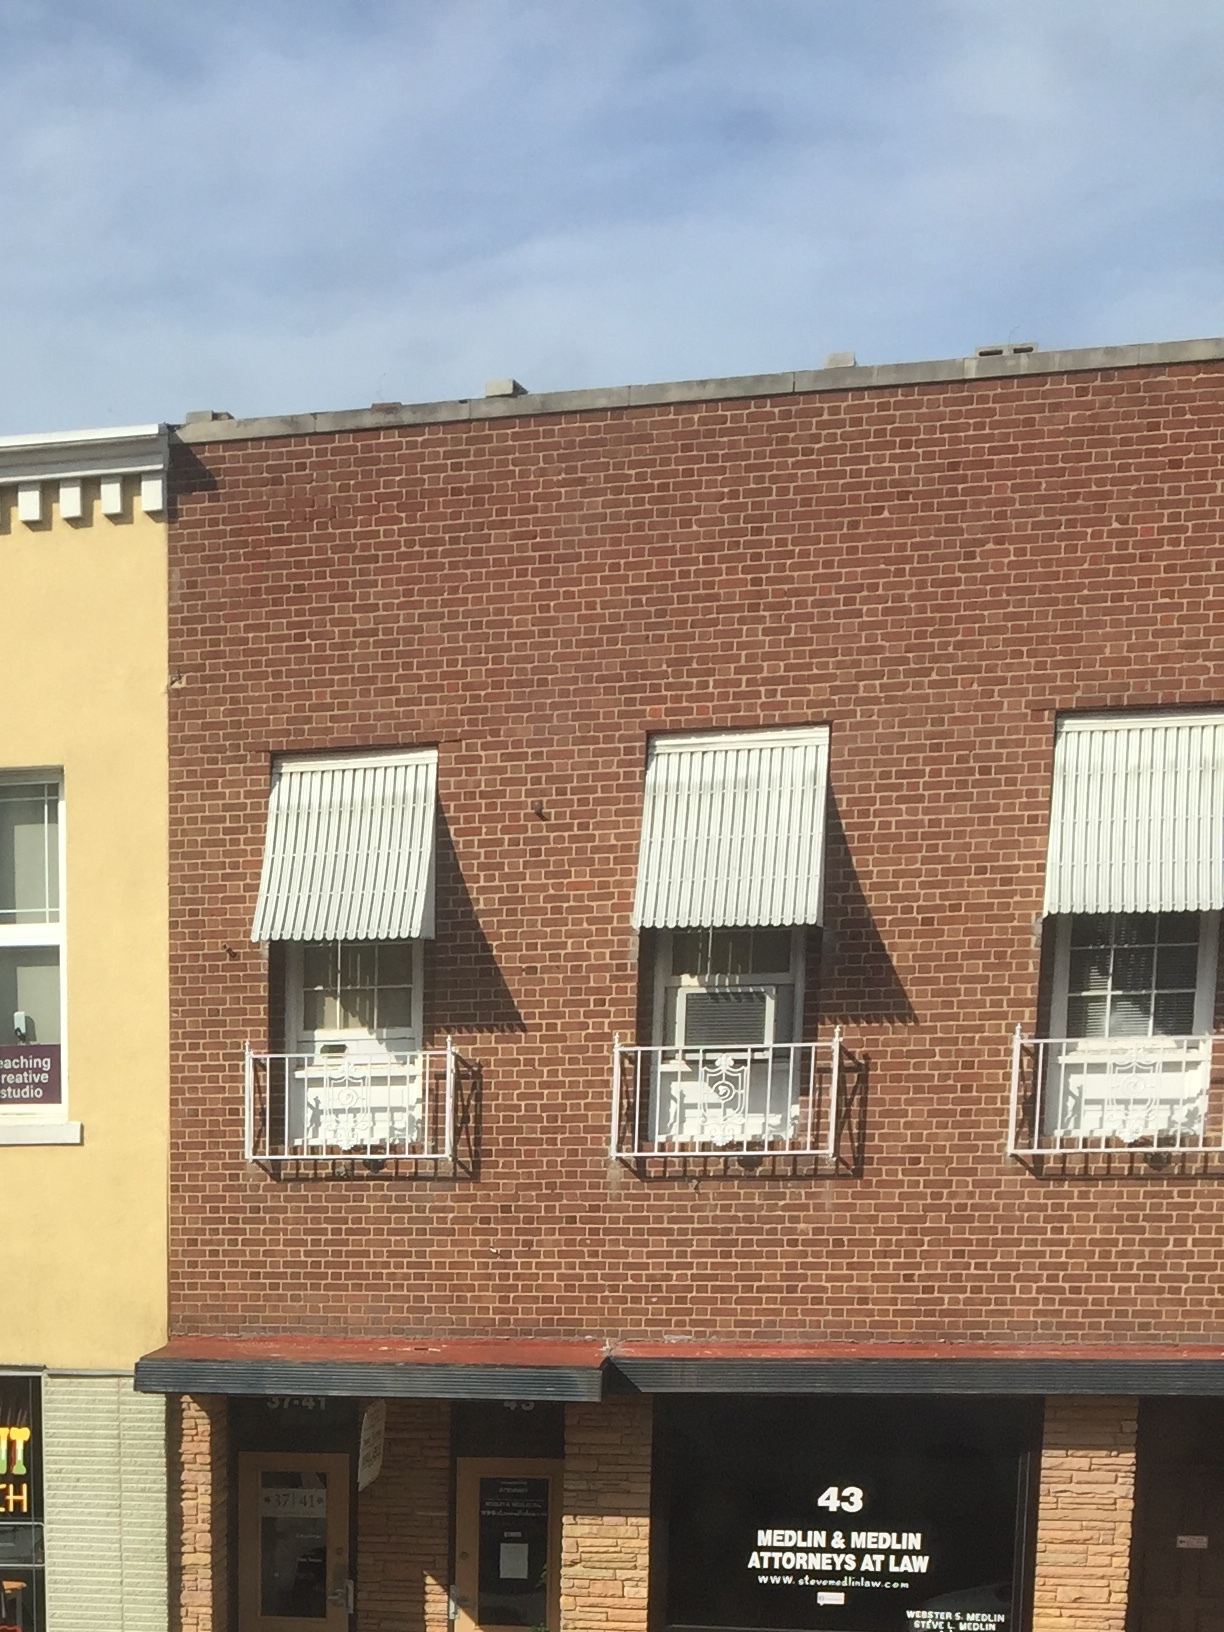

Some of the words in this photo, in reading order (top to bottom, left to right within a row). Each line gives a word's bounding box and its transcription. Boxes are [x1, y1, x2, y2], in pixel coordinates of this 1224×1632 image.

[0, 1085, 43, 1099] studio
[817, 1486, 864, 1513] 43
[757, 1529, 827, 1547] MEDLIN
[831, 1531, 846, 1549] &
[850, 1531, 922, 1550] MEDLIN
[747, 1551, 857, 1571] ATTORNEYS
[860, 1554, 885, 1572] AT
[888, 1555, 930, 1573] LAW
[906, 1610, 952, 1620] WEBSTER
[966, 1612, 1005, 1623] MEDLIN
[914, 1620, 944, 1630] STEVE
[959, 1622, 996, 1631] MEDLIN
